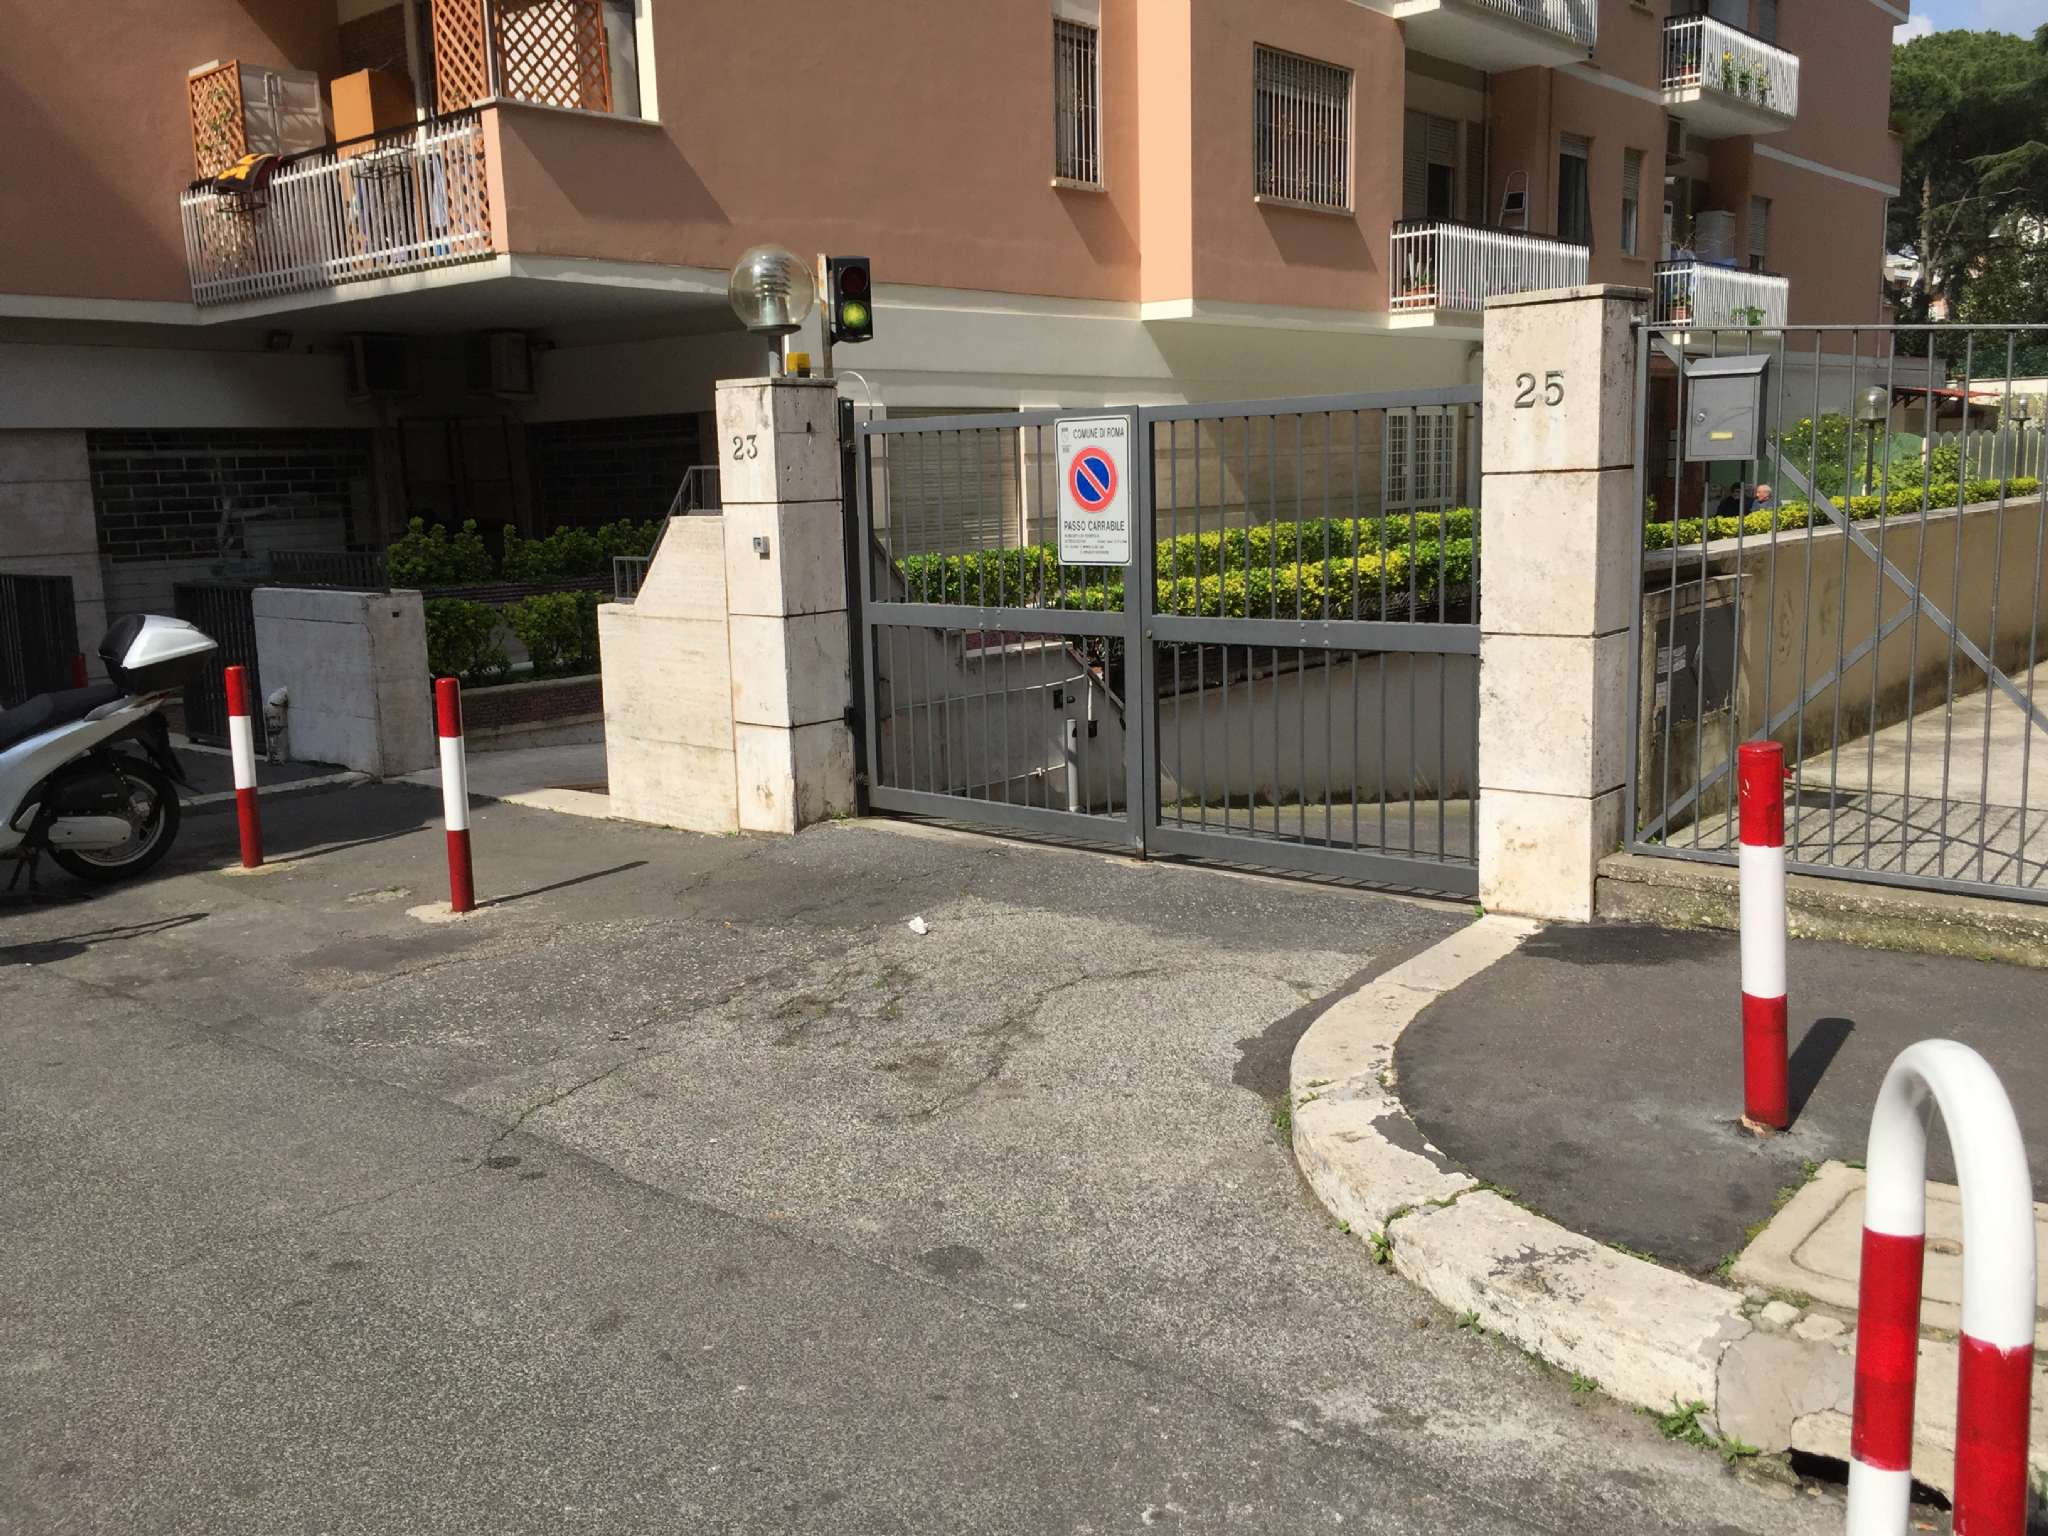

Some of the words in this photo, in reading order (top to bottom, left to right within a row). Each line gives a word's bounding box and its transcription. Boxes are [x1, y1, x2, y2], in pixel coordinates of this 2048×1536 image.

[1514, 370, 1564, 408] 25
[1072, 427, 1098, 439] COMUNE
[1099, 427, 1105, 438] DI
[1107, 425, 1124, 438] ROMA
[732, 434, 757, 460] 23
[1064, 520, 1085, 531] PASSO
[1087, 520, 1125, 531] CARRABILE
